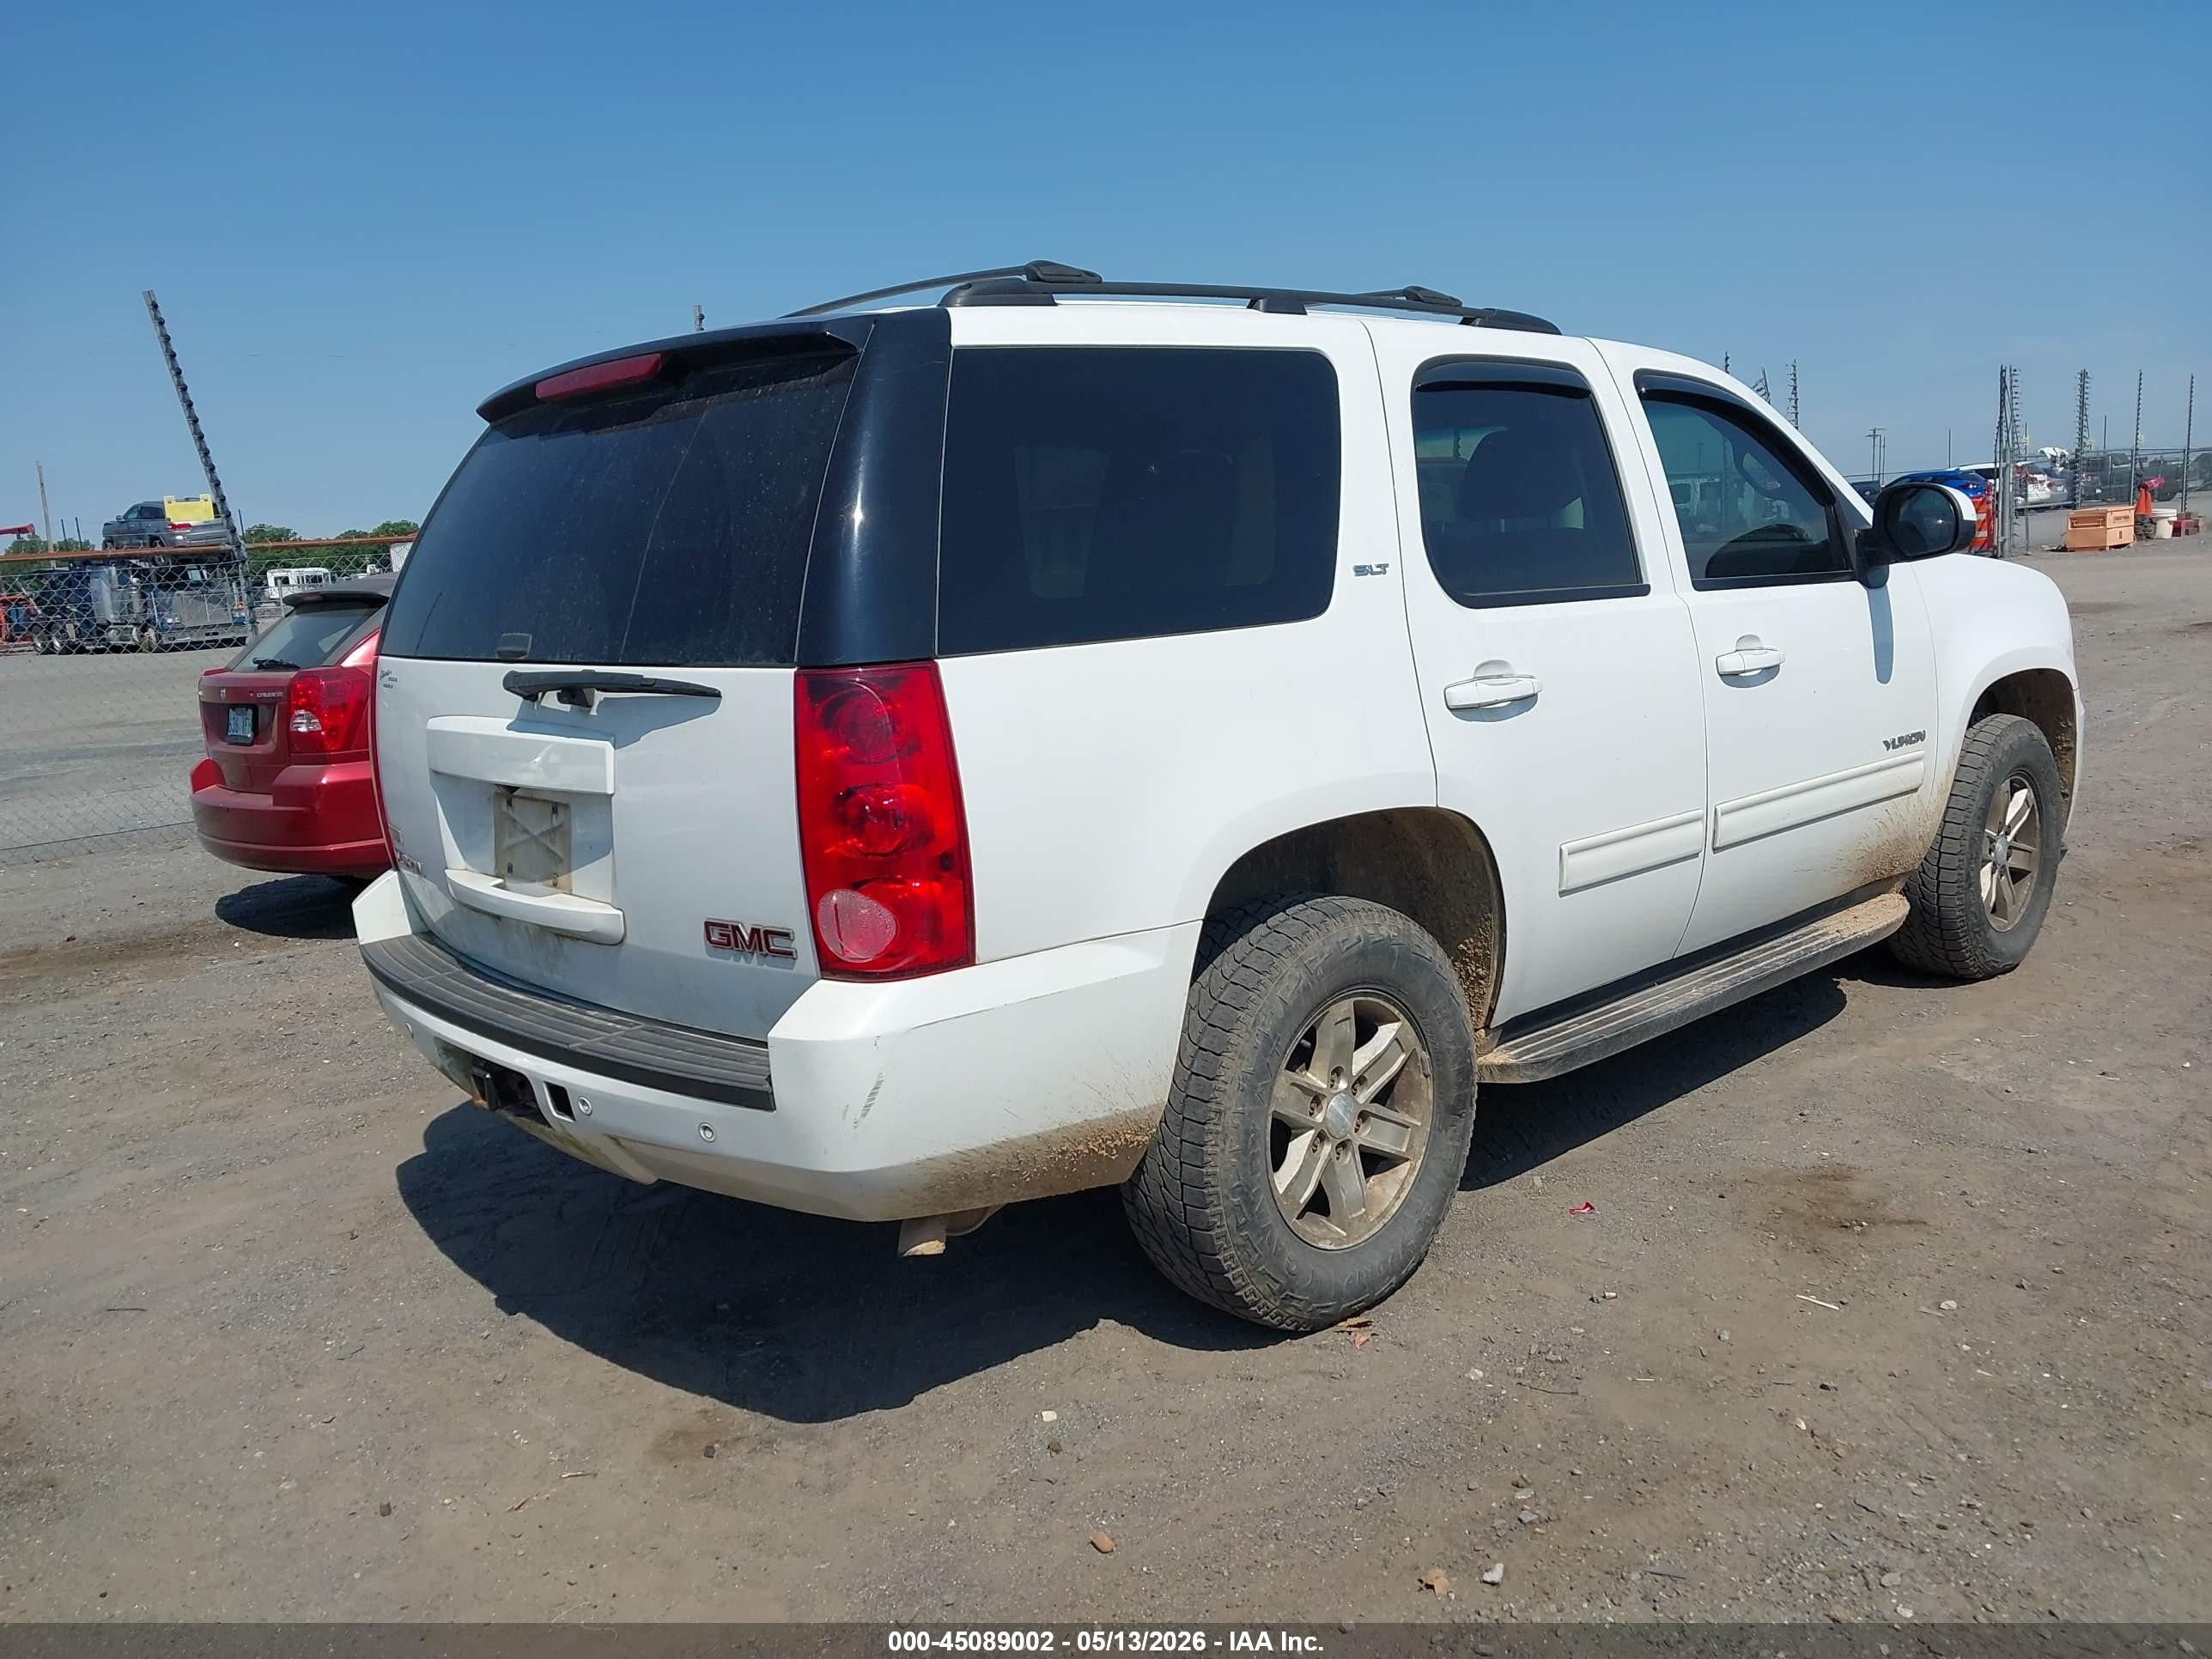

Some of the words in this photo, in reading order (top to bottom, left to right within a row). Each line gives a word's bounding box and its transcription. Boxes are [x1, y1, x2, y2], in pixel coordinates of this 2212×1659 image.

[1352, 563, 1389, 576] SLT
[1882, 730, 1926, 751] YUKON
[703, 917, 798, 960] GMC
